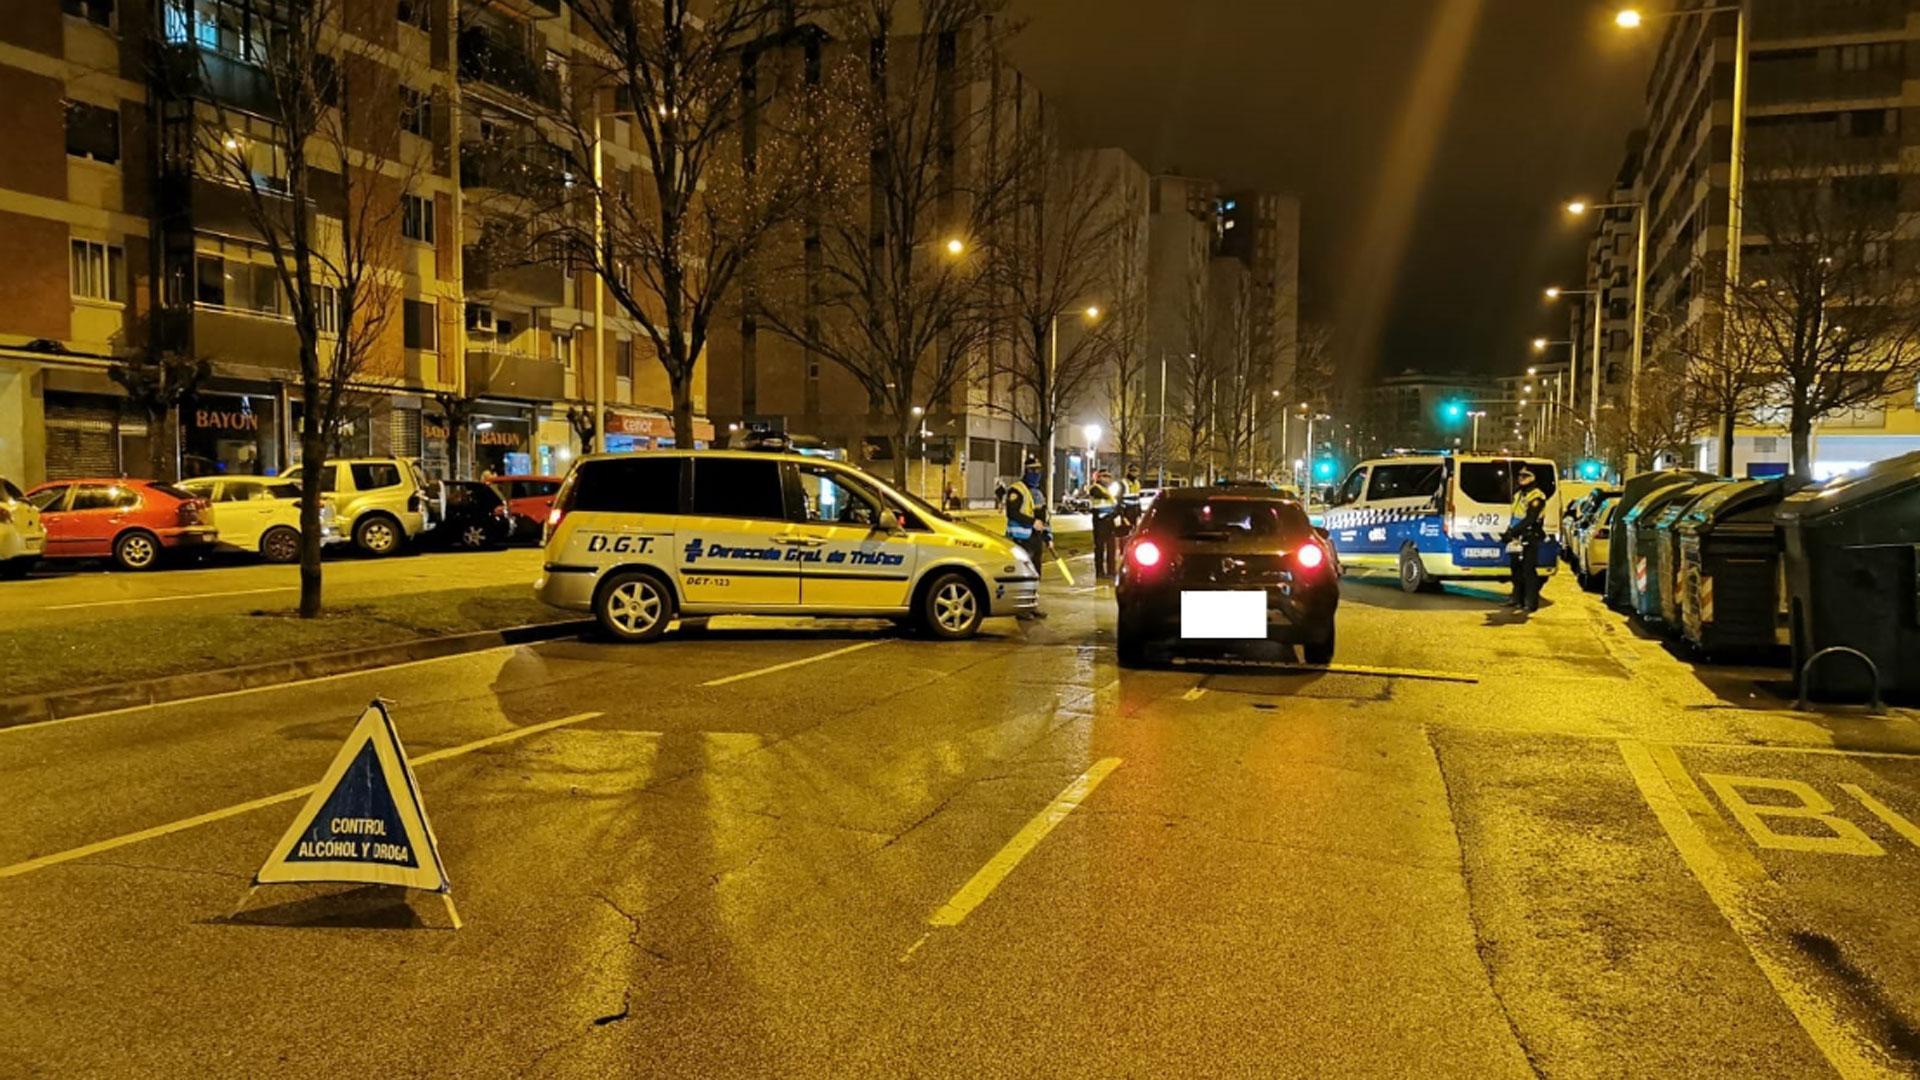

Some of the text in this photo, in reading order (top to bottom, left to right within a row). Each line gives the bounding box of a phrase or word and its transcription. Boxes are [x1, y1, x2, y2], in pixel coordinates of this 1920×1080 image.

[196, 410, 259, 430] BAYON
[423, 425, 450, 438] BAYO
[481, 431, 521, 446] BAYON
[1477, 513, 1500, 526] 092
[588, 535, 655, 554] D.G.T.
[826, 550, 847, 562] de
[330, 817, 387, 836] CONTROL
[298, 841, 409, 862] ALCOHOL Y DROGA
